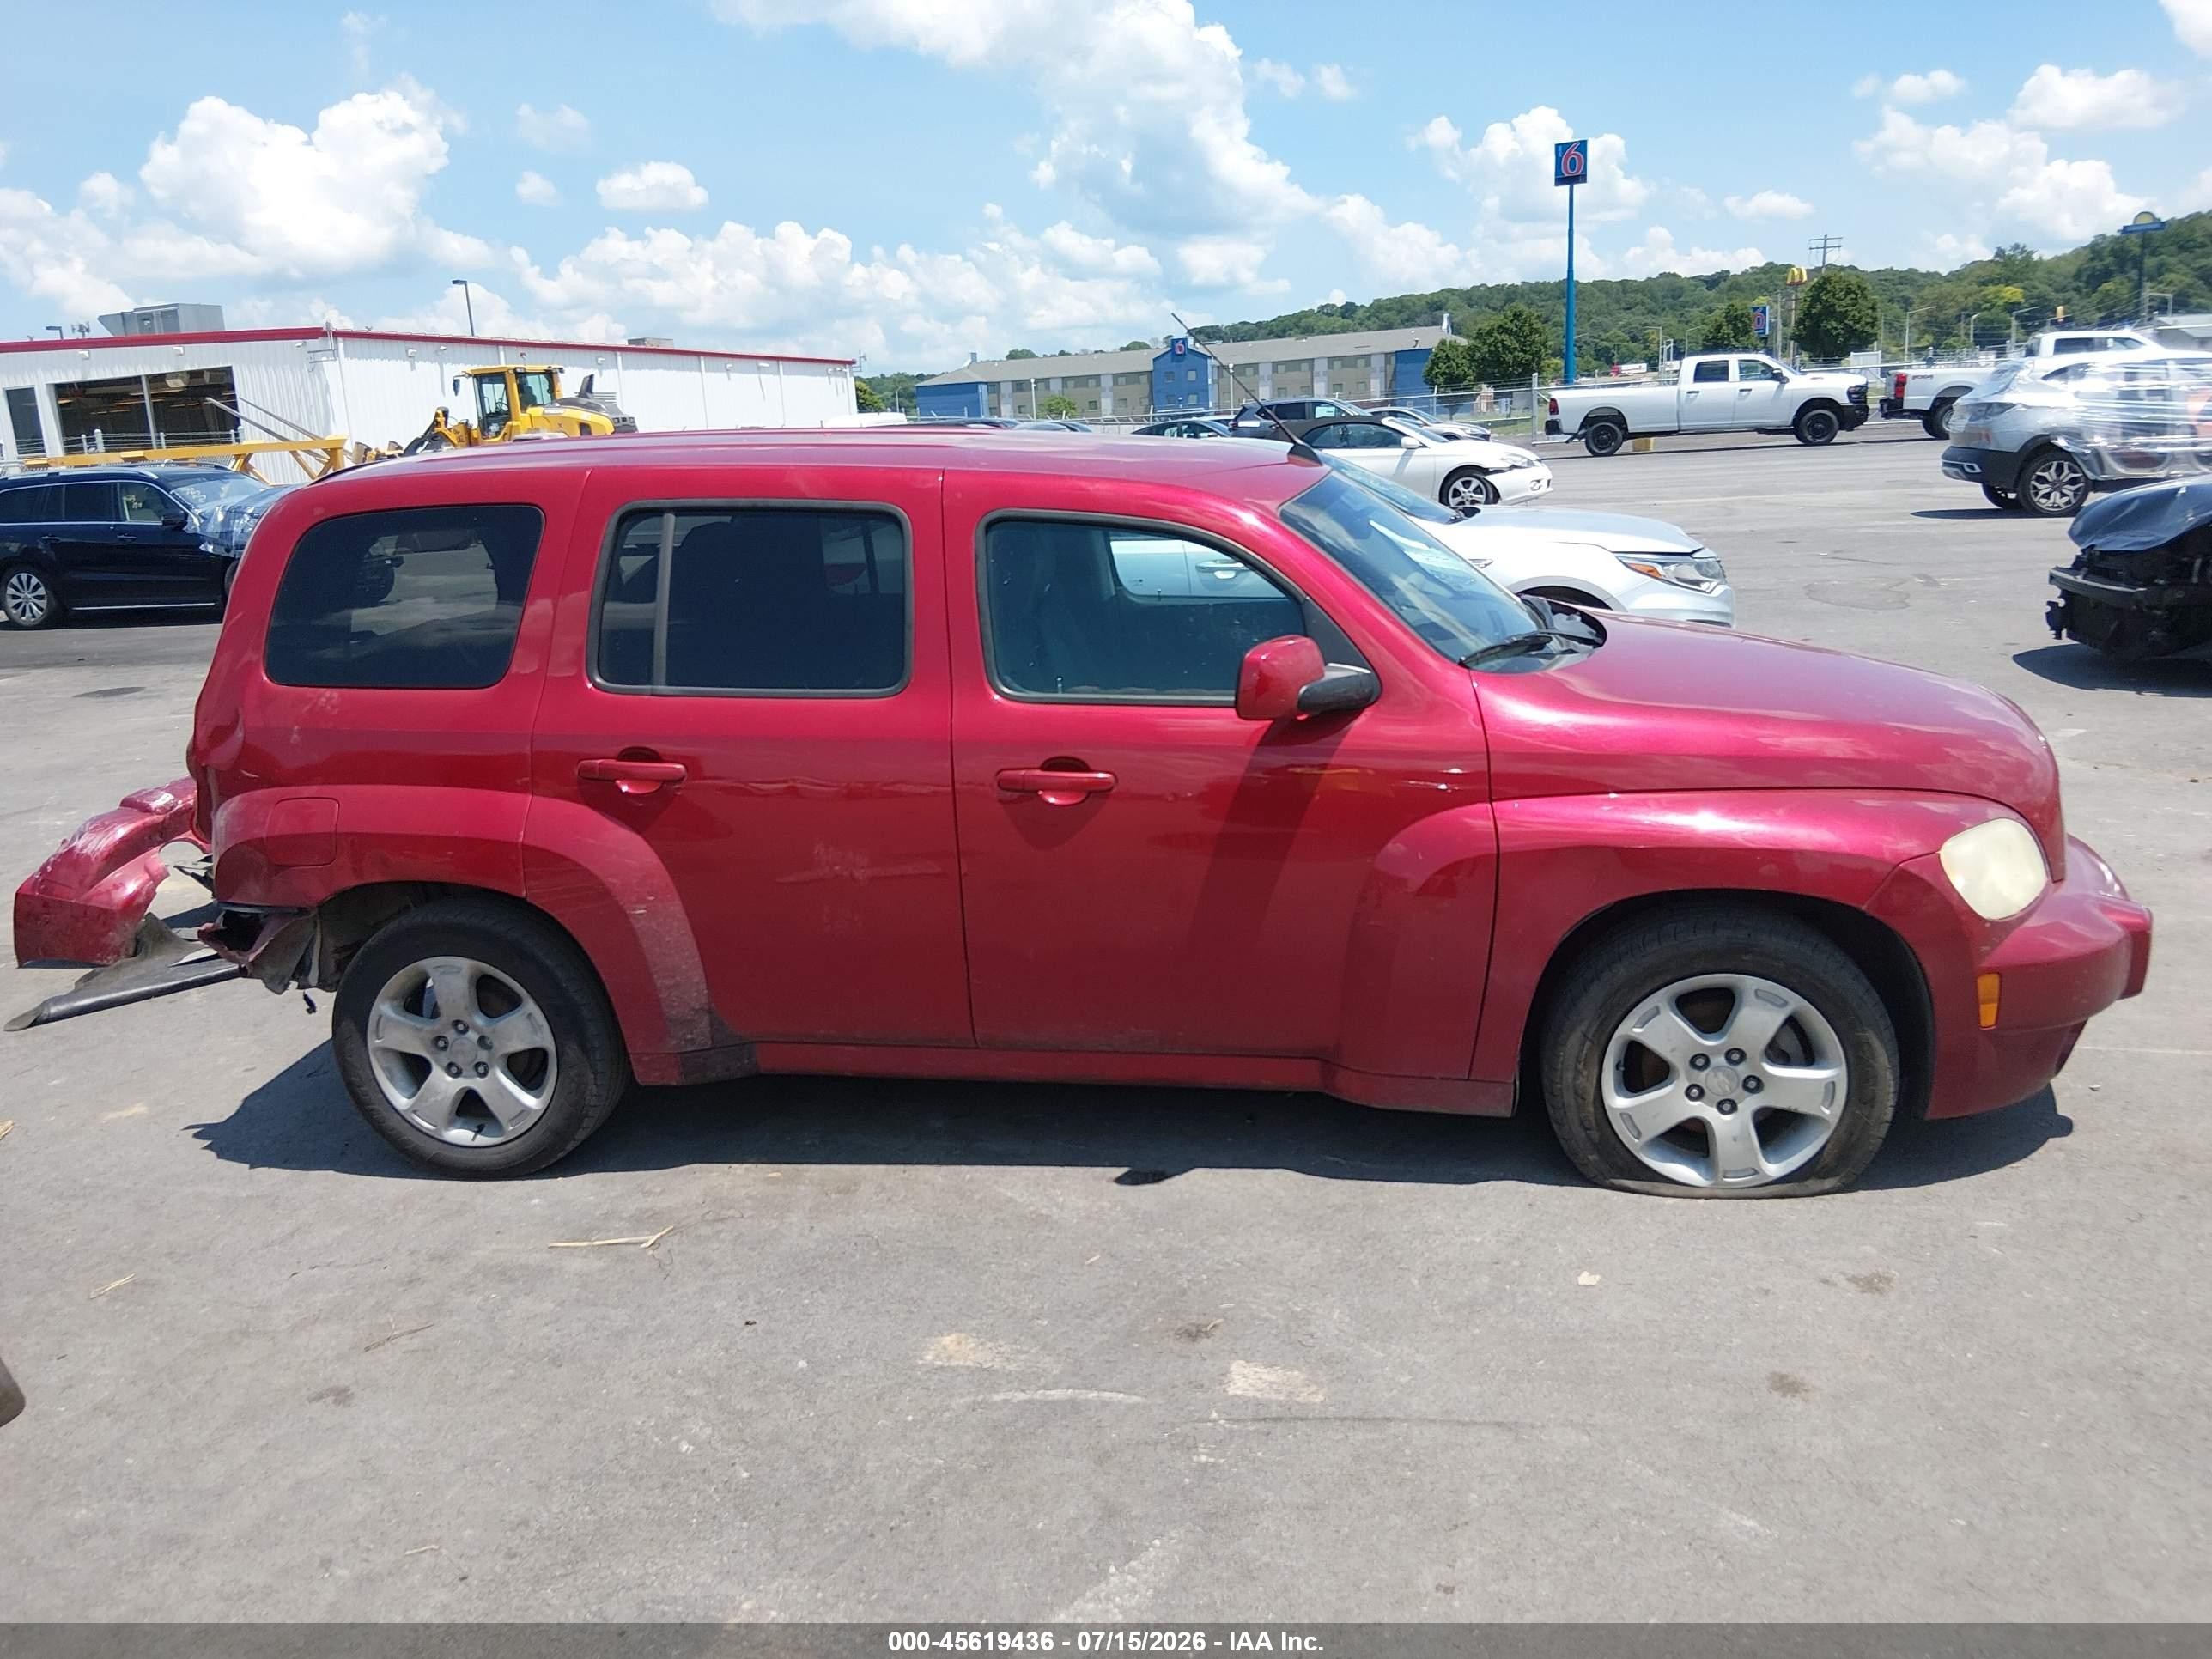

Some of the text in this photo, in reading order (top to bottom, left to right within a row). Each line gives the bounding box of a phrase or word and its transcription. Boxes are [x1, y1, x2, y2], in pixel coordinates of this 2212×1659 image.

[1561, 142, 1584, 176] 6
[1753, 307, 1765, 330] 6
[1174, 339, 1185, 355] 6
